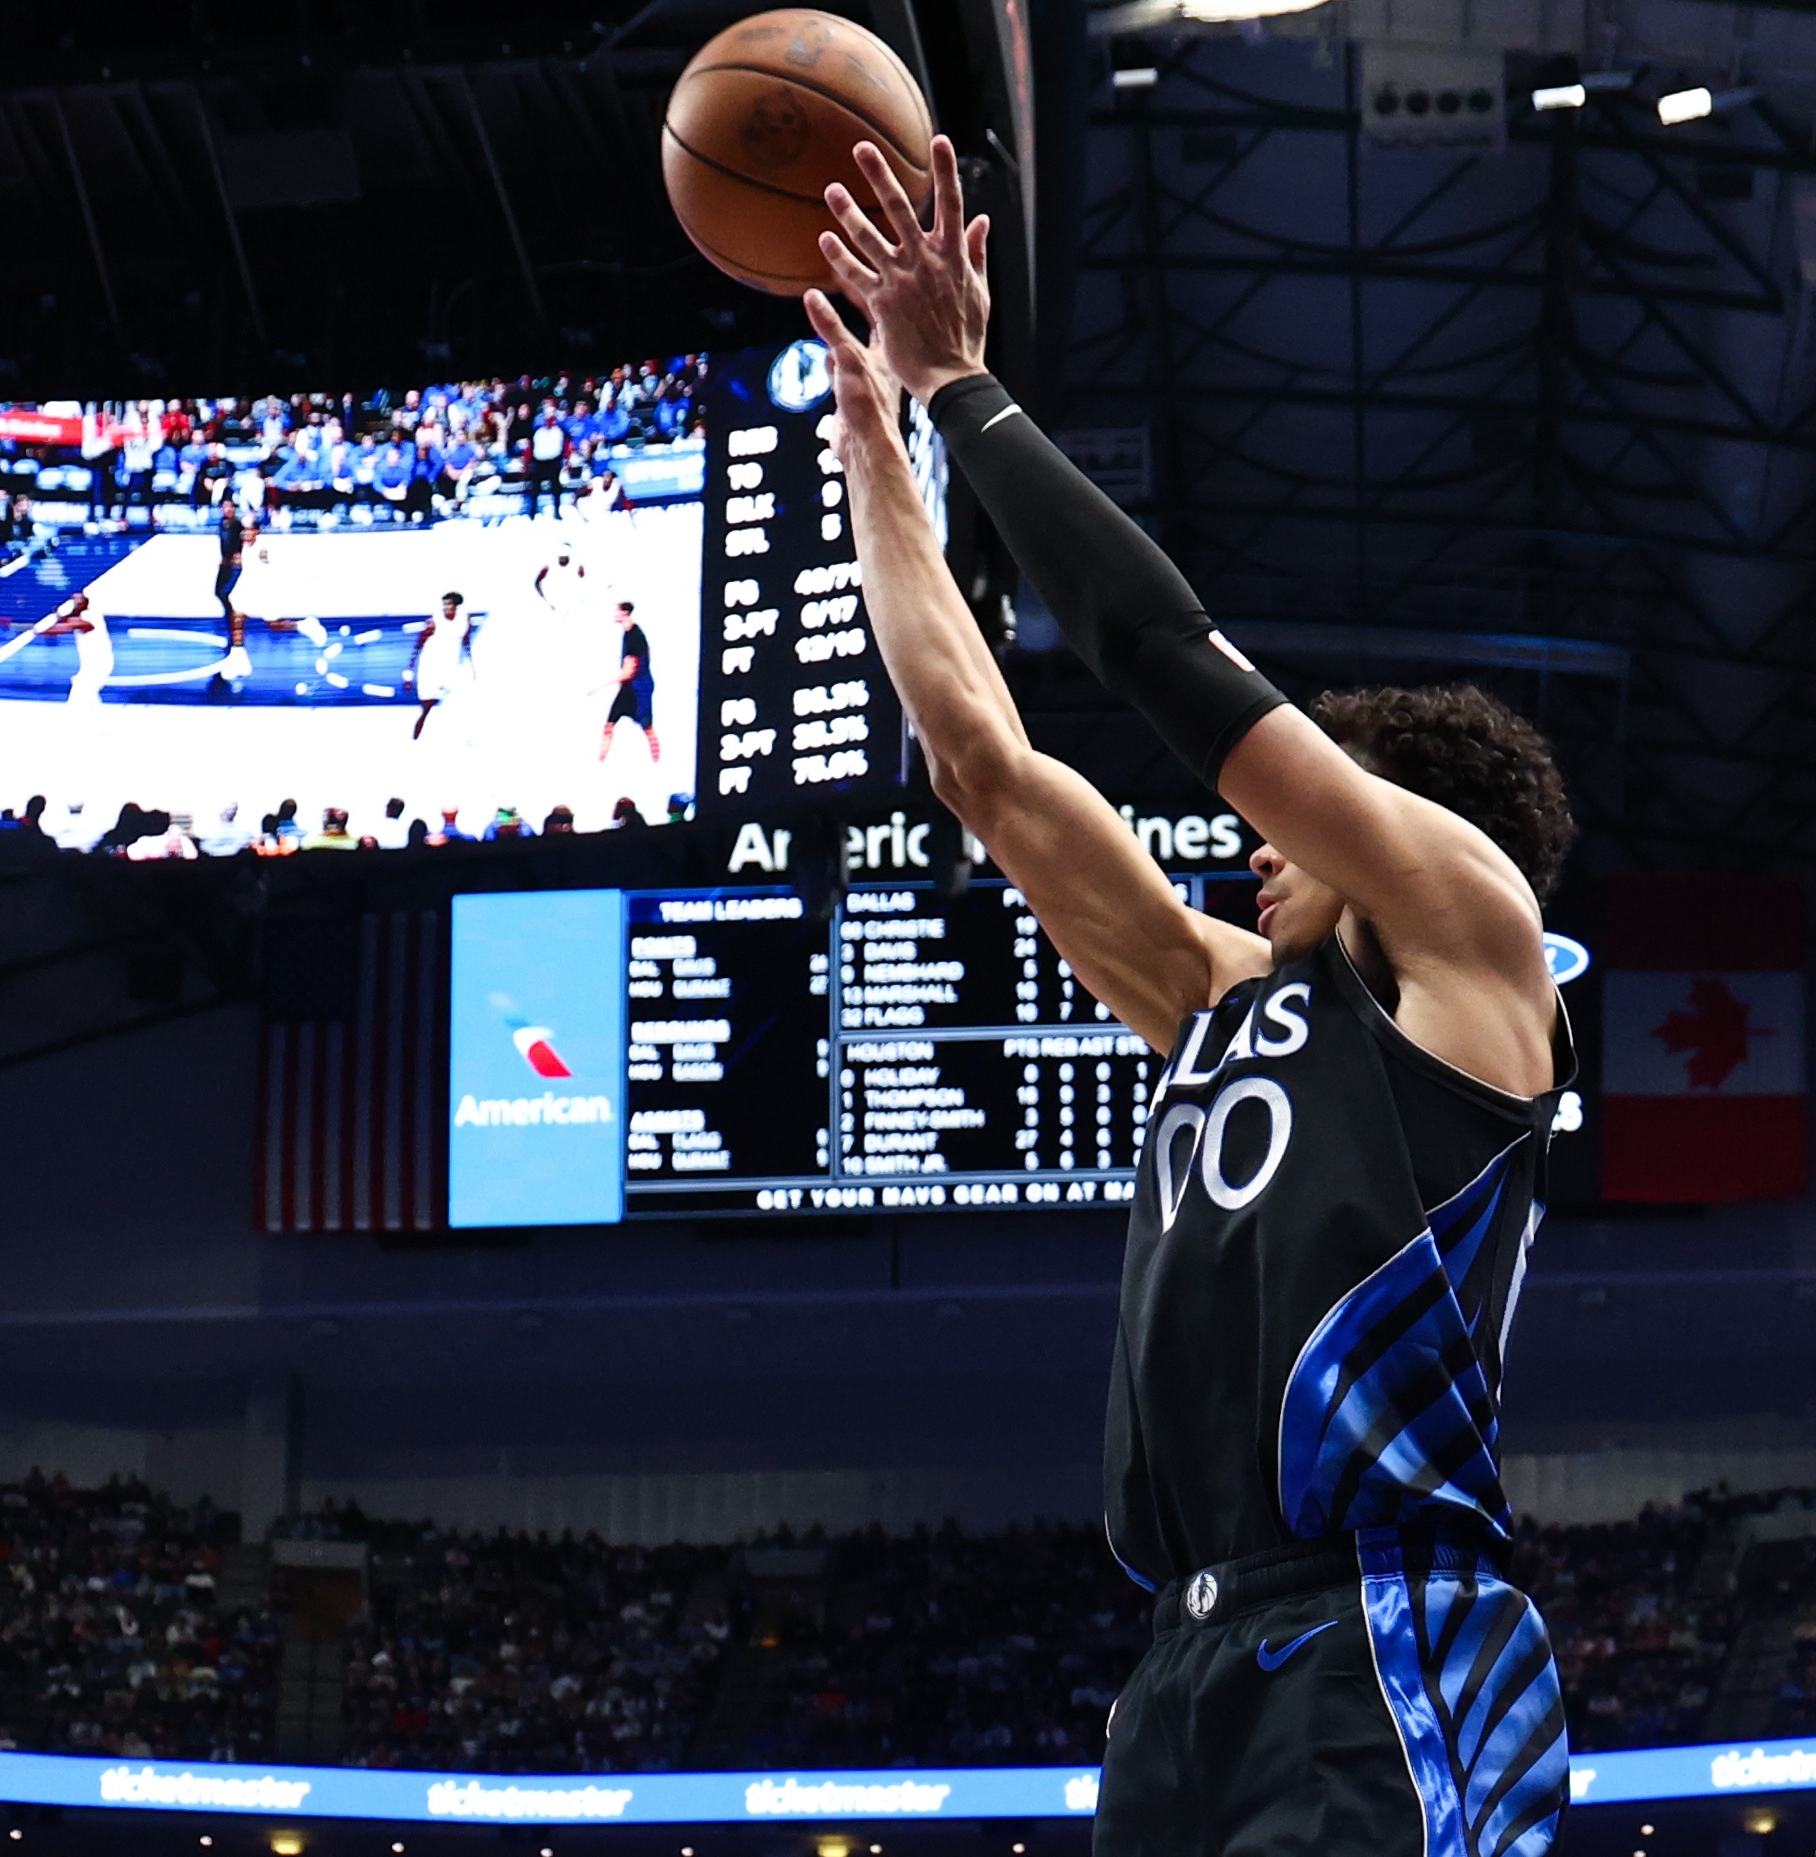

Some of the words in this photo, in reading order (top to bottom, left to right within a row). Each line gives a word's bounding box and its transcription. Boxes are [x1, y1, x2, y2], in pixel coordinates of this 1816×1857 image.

[659, 901, 713, 922] TEAM
[715, 898, 803, 920] LEADERS
[846, 892, 915, 913] DALLAS
[864, 918, 945, 938] CHRISTIE
[847, 1041, 934, 1061] HOUSTON
[1148, 981, 1312, 1118] LAS
[864, 1067, 941, 1087] HOLIDAY
[454, 1092, 614, 1128] American
[865, 1088, 965, 1108] THOMPSON
[864, 1132, 937, 1152] DURANT
[757, 1190, 803, 1210] GET
[810, 1187, 875, 1210] YOUR
[884, 1185, 946, 1208] MAVS
[1025, 1182, 1060, 1204] ON
[1066, 1181, 1098, 1203] AT
[100, 1766, 311, 1809] ticketmaster
[427, 1780, 633, 1818] ticketmaster
[745, 1778, 951, 1814] ticketmaster
